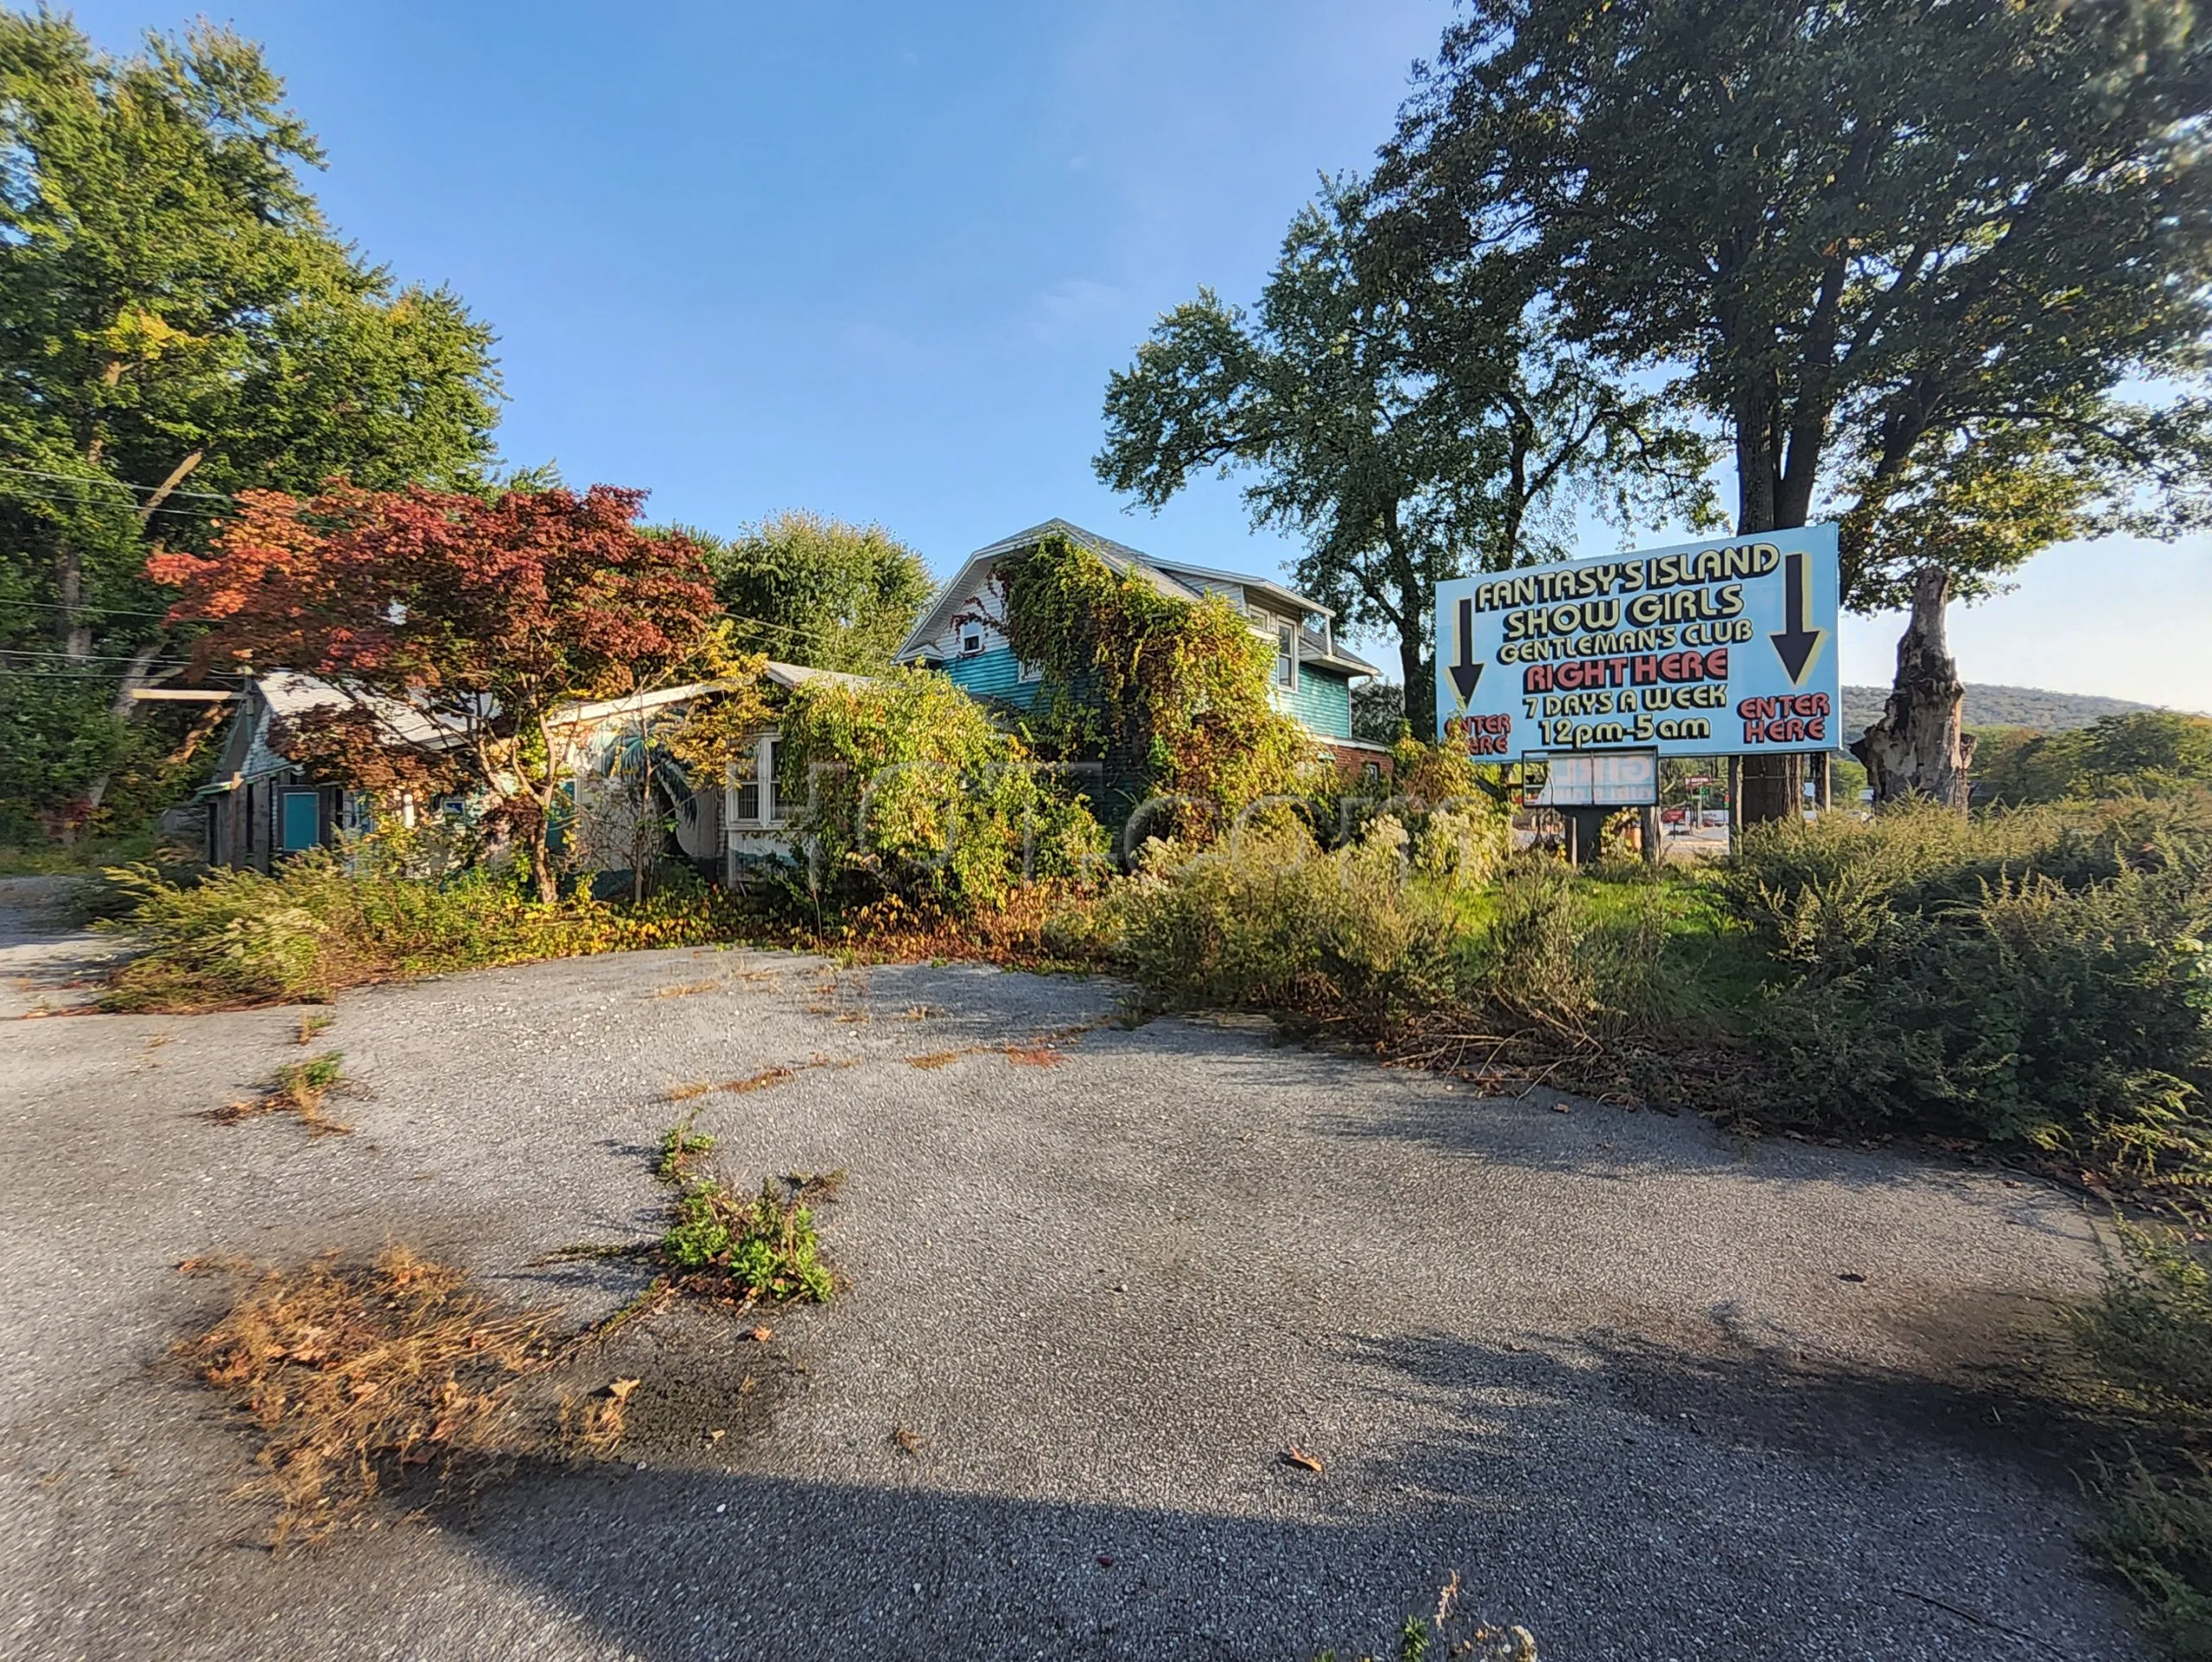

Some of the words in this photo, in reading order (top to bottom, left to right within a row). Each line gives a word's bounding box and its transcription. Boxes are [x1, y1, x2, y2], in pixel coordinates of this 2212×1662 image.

[1475, 560, 1644, 613] FANTASY'S
[1646, 543, 1780, 590] ISLAND
[1503, 598, 1620, 643] SHOW
[1624, 583, 1744, 628] GIRLS
[1497, 626, 1677, 665] GENTLEMAN'S
[1681, 618, 1753, 647] CLUB
[1523, 657, 1630, 694] RIGHT
[1630, 648, 1728, 686] HERE
[1522, 697, 1538, 719] 7
[1543, 691, 1614, 717] DAYS
[1618, 689, 1638, 713] A
[1642, 684, 1728, 711] WEEK
[1737, 692, 1830, 719] ENTER
[1468, 735, 1508, 755] ERE
[1538, 714, 1711, 749] 12pm-5am
[1744, 716, 1825, 743] HERE
